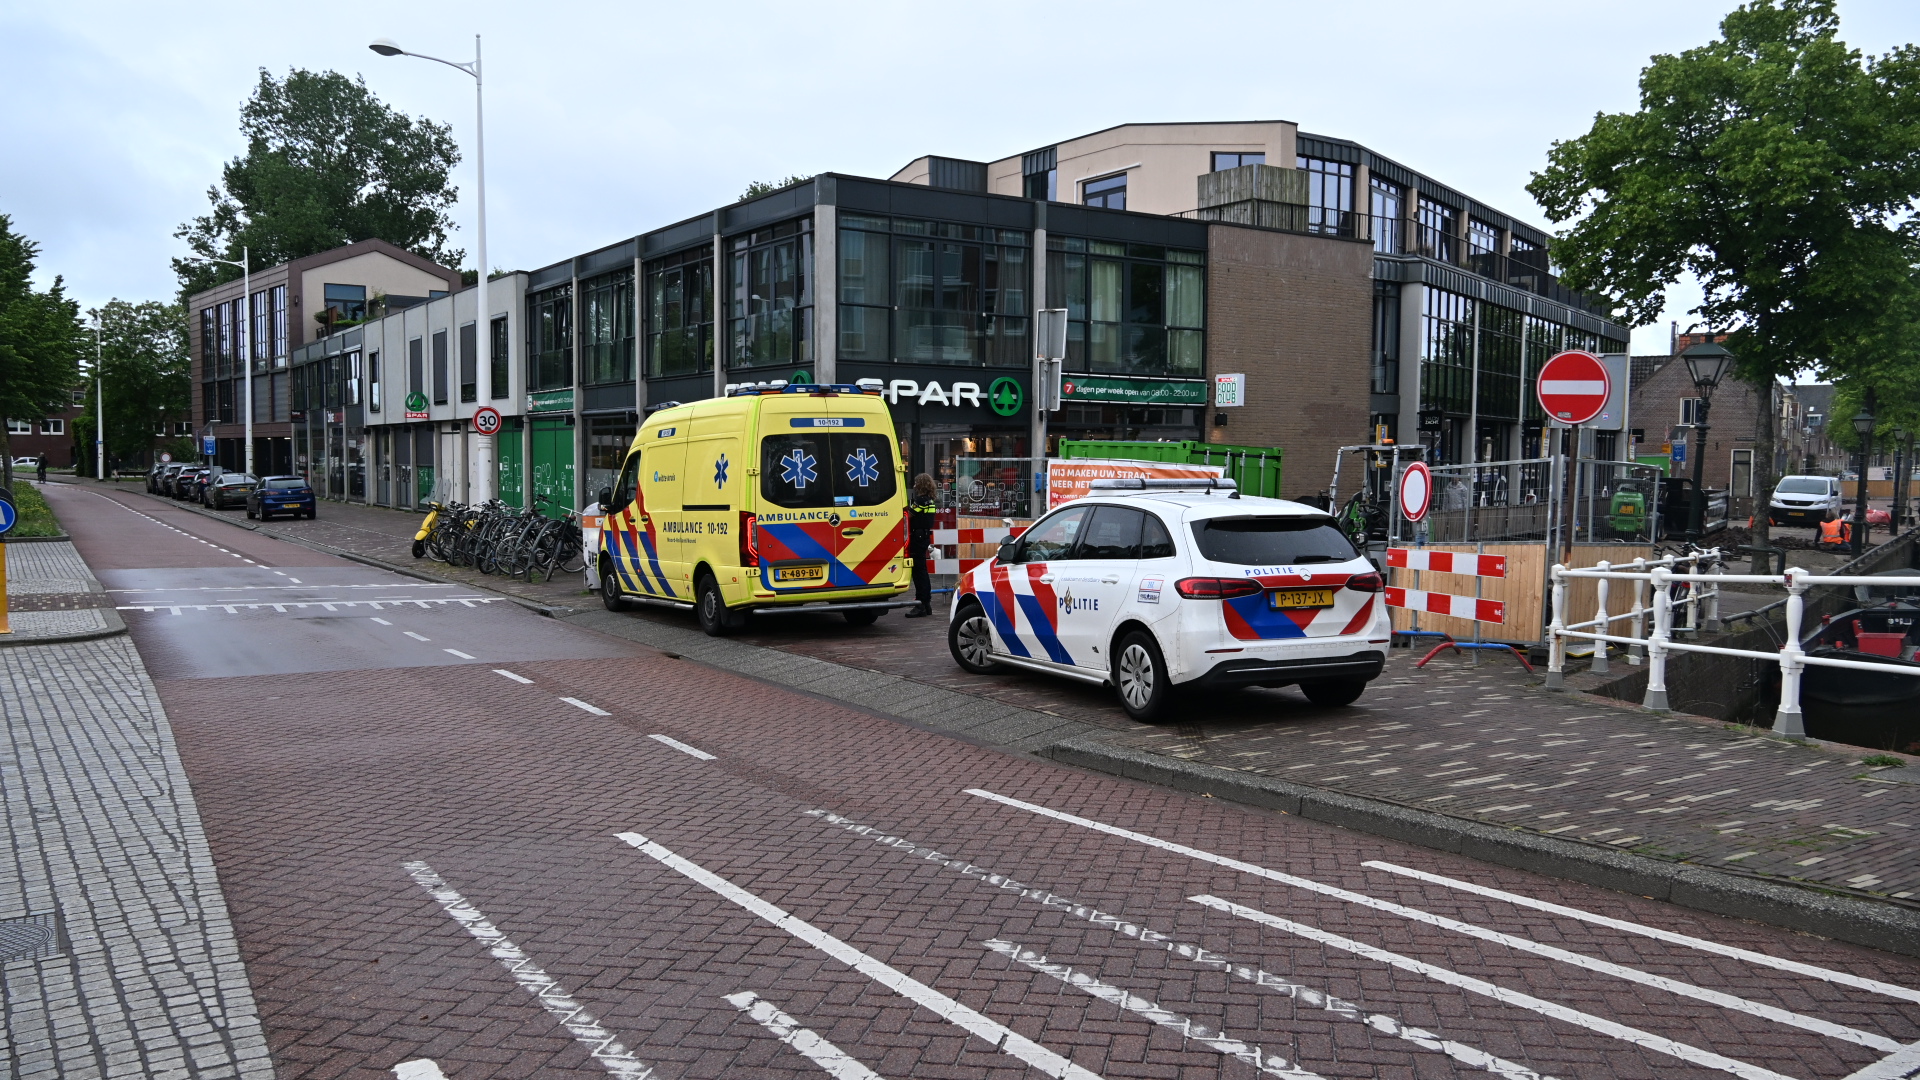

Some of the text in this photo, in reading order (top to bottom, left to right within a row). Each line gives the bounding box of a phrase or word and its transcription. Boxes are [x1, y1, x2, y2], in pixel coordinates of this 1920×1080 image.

[1076, 386, 1095, 394] dagen
[1095, 387, 1107, 395] per
[1218, 383, 1236, 392] FOOD
[1218, 393, 1236, 403] CLUB
[479, 415, 497, 427] 30
[1051, 468, 1152, 479] WIJ MAKEN UW STRAAT
[1051, 480, 1073, 488] WEER
[757, 511, 829, 522] AMBULANCE
[663, 522, 728, 535] AMBULANCE 10-192
[781, 568, 820, 578] R-489-BV
[1245, 566, 1295, 577] POLITIE
[1280, 592, 1325, 605] P-137-JX
[1059, 597, 1099, 614] POLITIE
